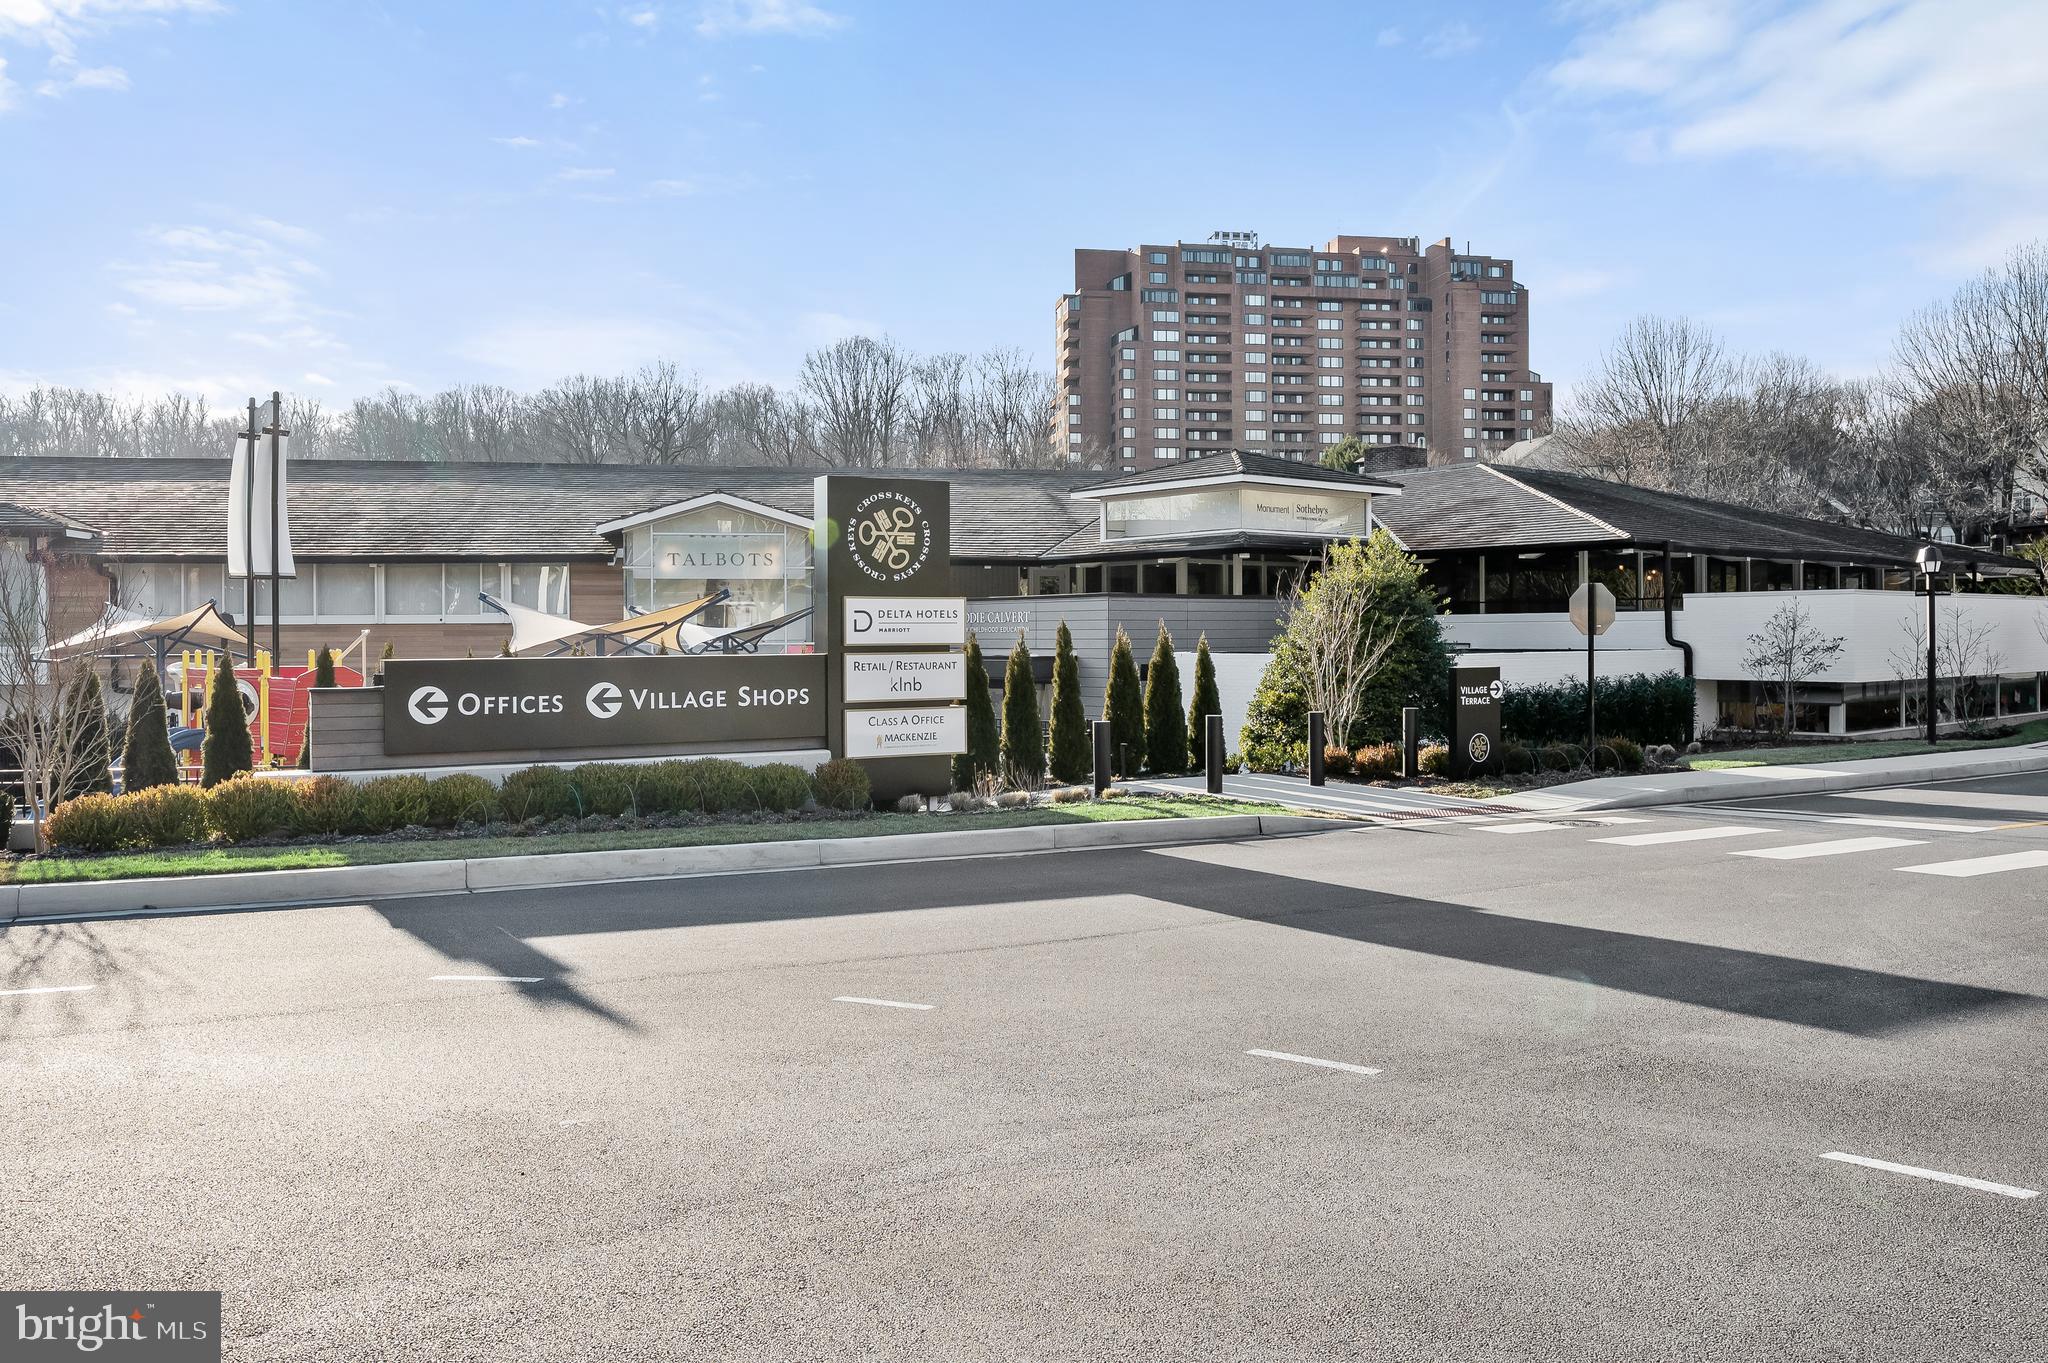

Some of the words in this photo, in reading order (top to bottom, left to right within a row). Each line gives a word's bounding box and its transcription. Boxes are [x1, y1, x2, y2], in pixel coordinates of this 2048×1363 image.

[856, 491, 892, 513] CROSS
[894, 492, 922, 515] KEYS
[1256, 504, 1290, 514] Monument
[1296, 503, 1329, 517] Sotheby's
[847, 517, 857, 551] KEYS
[919, 520, 931, 562] CROSS
[667, 552, 774, 567] TALBOTS
[852, 553, 886, 581] CROSS
[893, 561, 921, 581] KEYS
[878, 609, 912, 619] DELTA
[916, 609, 958, 619] HOTELS
[987, 611, 1031, 623] CALVERT
[890, 676, 922, 692] klnb
[900, 715, 909, 725] A
[884, 732, 938, 742] MACKENZIE
